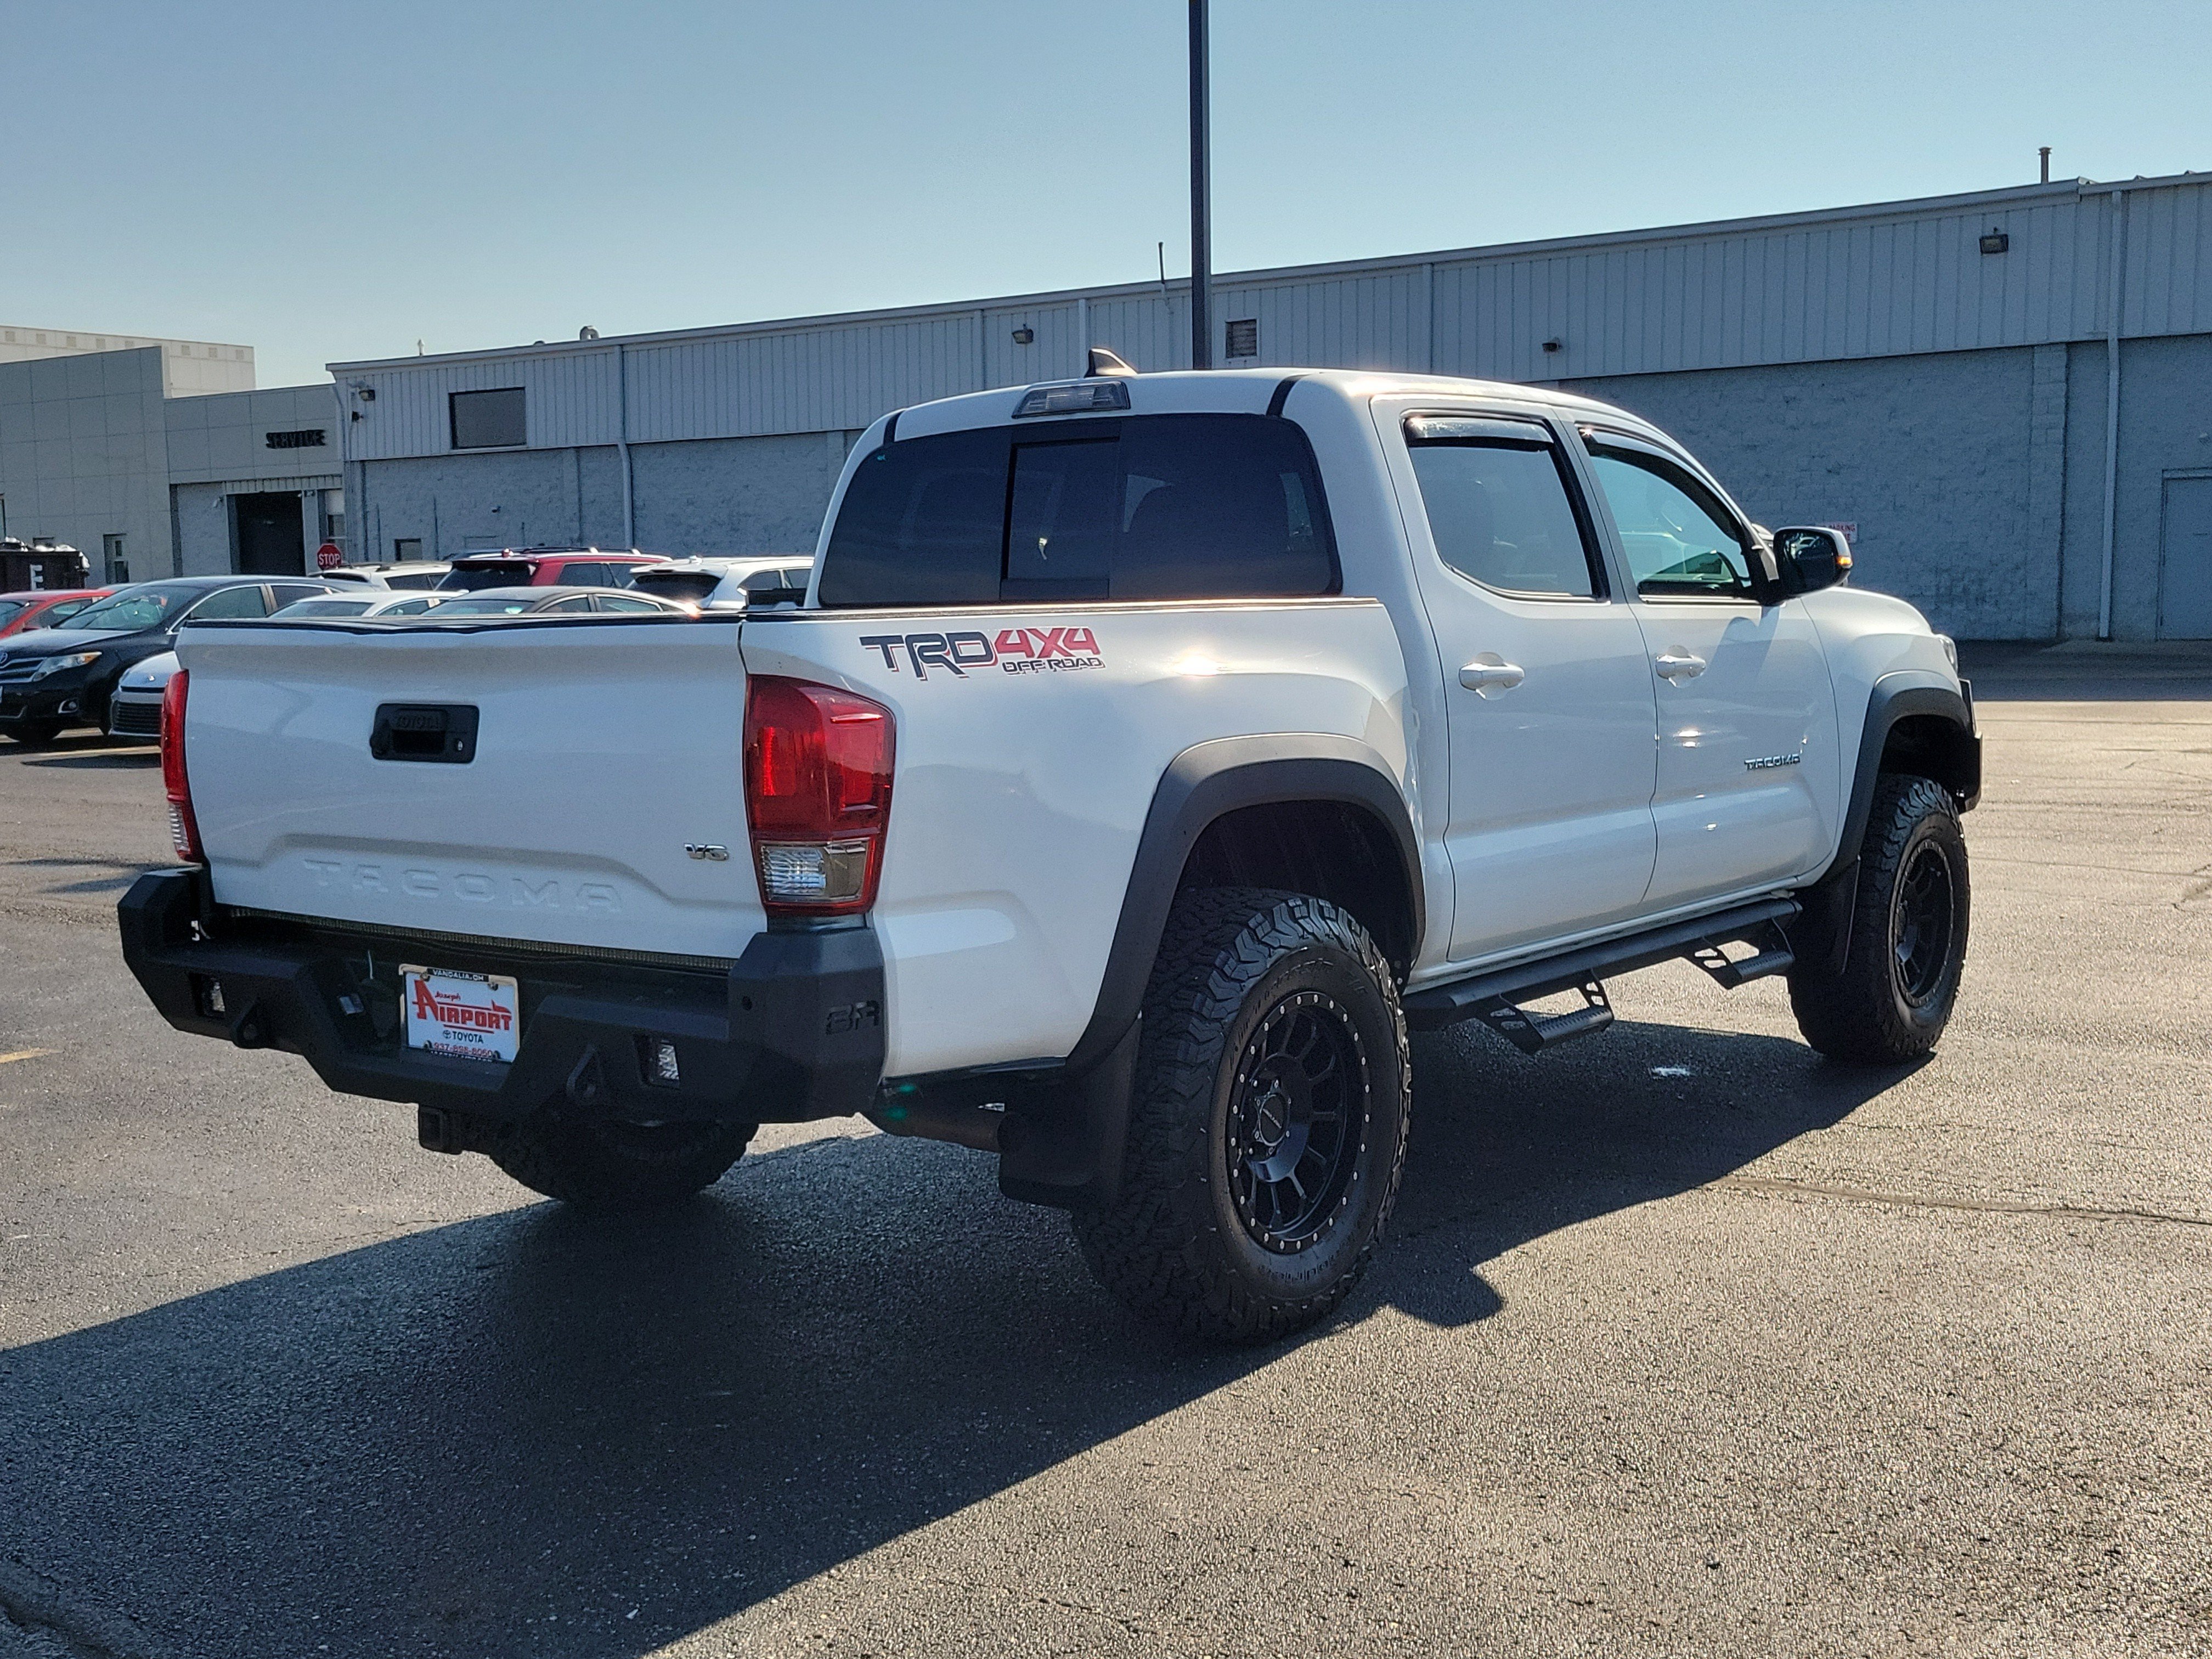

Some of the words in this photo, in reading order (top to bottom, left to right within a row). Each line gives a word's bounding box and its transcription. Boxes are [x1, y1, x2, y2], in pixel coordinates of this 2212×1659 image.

[266, 430, 326, 449] SERVICE
[318, 553, 341, 567] STOP
[859, 631, 998, 681] TRD
[1002, 660, 1046, 675] OFF
[1047, 657, 1106, 672] ROAD
[1743, 753, 1801, 770] TACOMA
[684, 843, 730, 861] V6
[304, 858, 623, 913] TACOMA
[413, 980, 512, 1030] AIRPORT
[435, 991, 461, 1002] Joseph
[453, 1031, 484, 1043] TOYOTA
